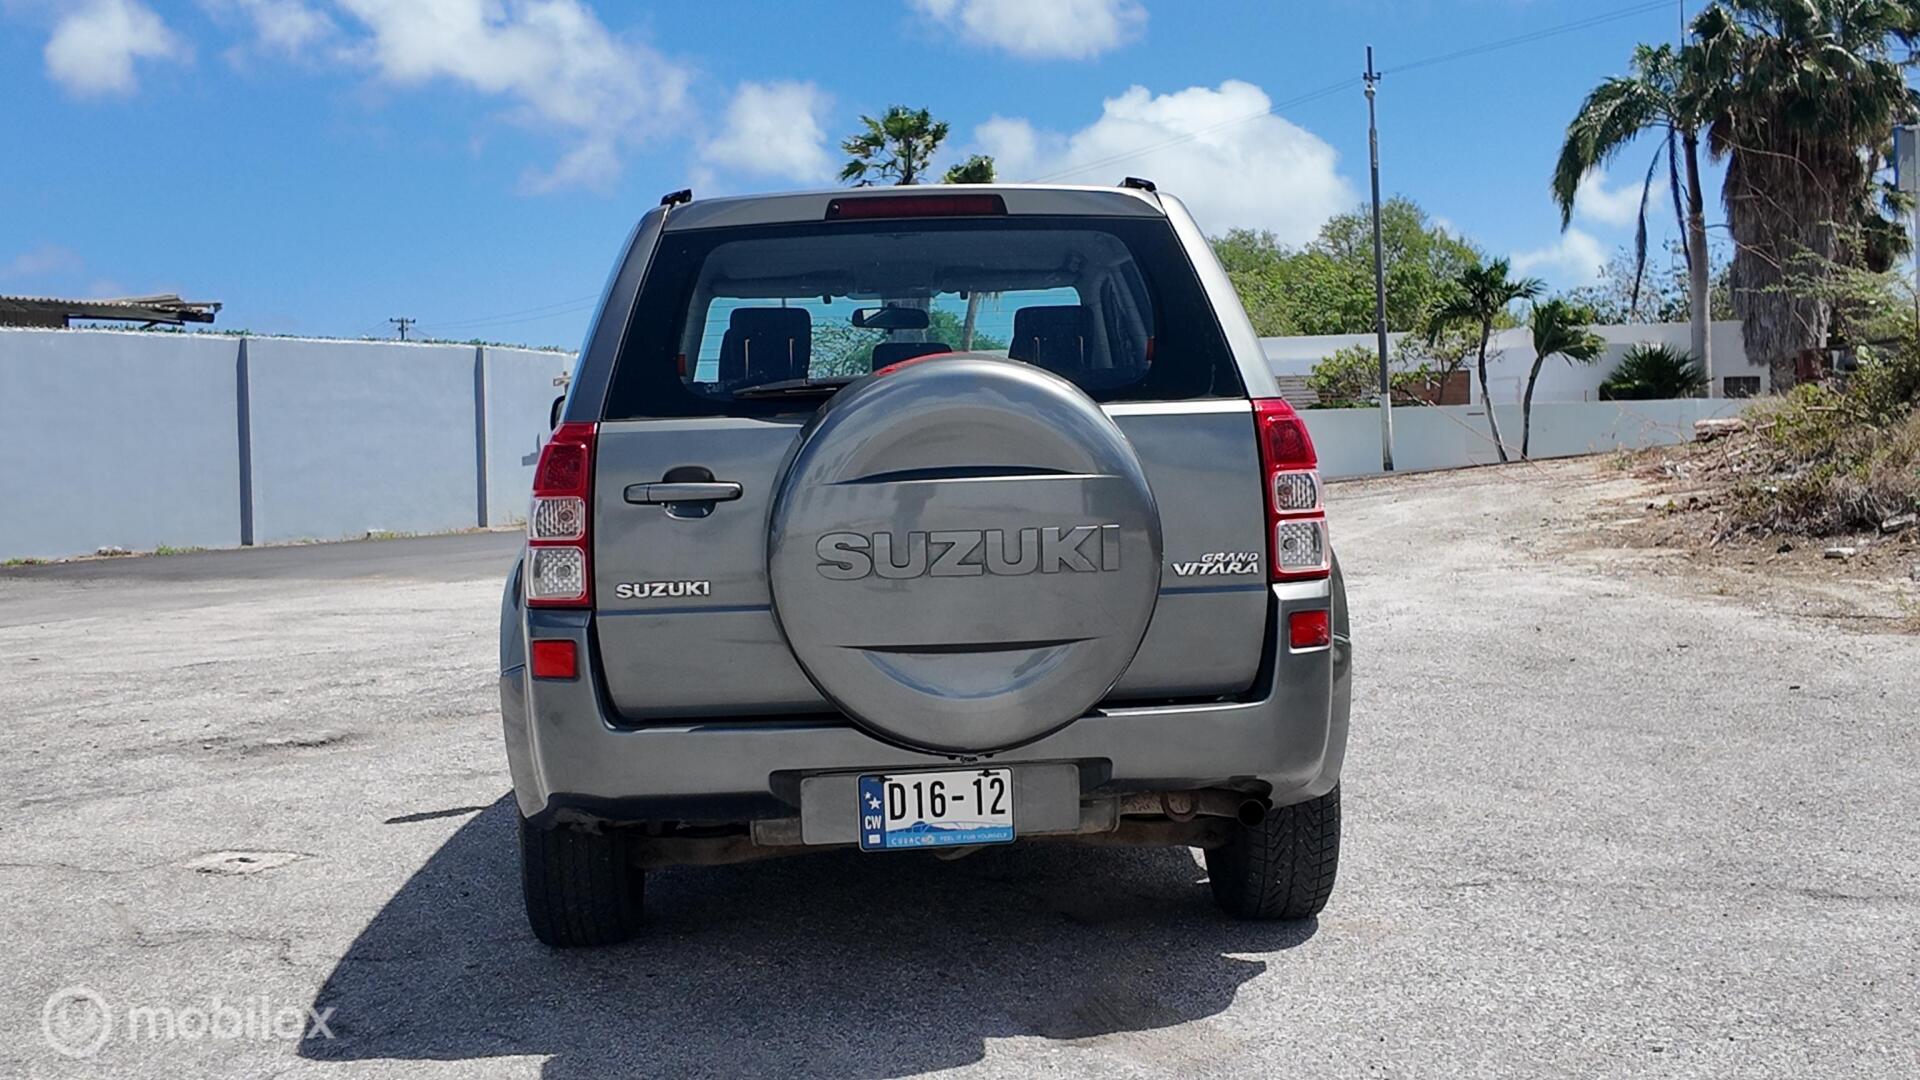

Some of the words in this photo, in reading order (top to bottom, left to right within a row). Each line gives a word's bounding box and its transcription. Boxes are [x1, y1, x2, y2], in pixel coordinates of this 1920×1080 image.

[815, 523, 1121, 582] SUZUKI
[1201, 551, 1259, 564] GRAND
[1171, 561, 1260, 576] VITARA
[615, 580, 711, 599] SUZUKI
[888, 777, 1006, 821] D16-12
[864, 815, 882, 830] CW
